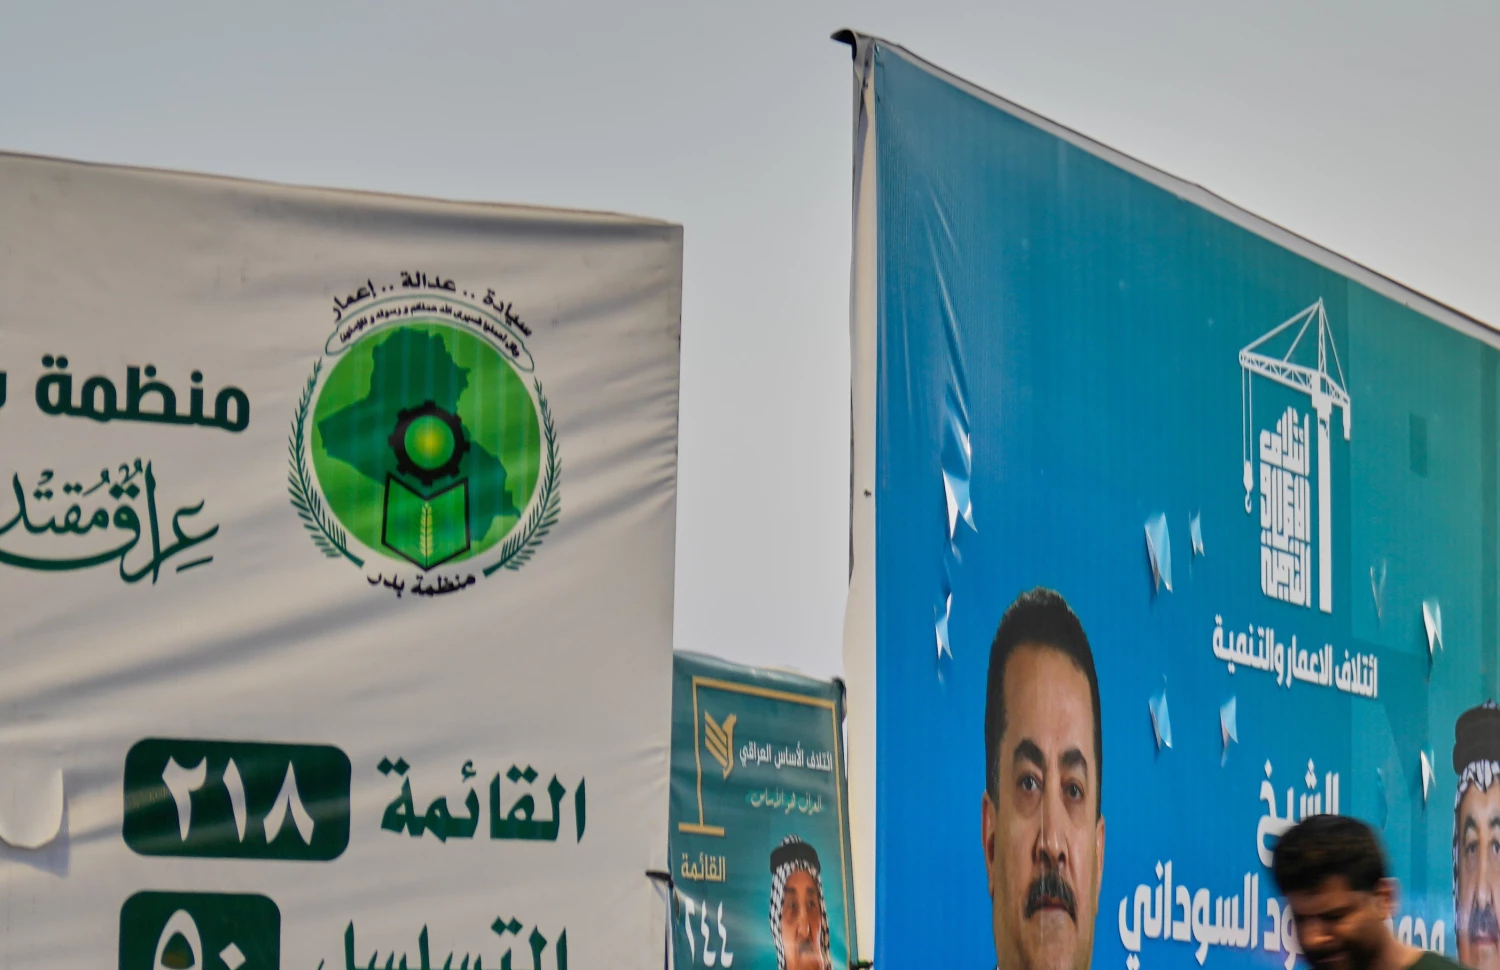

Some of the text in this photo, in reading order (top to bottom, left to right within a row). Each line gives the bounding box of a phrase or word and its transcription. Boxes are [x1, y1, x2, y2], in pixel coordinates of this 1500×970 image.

[333, 279, 376, 323] إعمار
[401, 271, 456, 291] عدالة
[483, 289, 533, 338] سيادة
[35, 355, 250, 433] منظمة
[366, 572, 475, 598] منظمة بدر
[1212, 614, 1284, 688] والتنمية
[1335, 648, 1378, 699] ائتلاف
[738, 741, 772, 769] العراقي
[773, 741, 804, 771] الأساس
[161, 754, 586, 844] القائمة ٢١٨
[1256, 758, 1340, 869] الشيخ
[681, 851, 727, 883] القائمة
[684, 897, 734, 969] ٢٤٤
